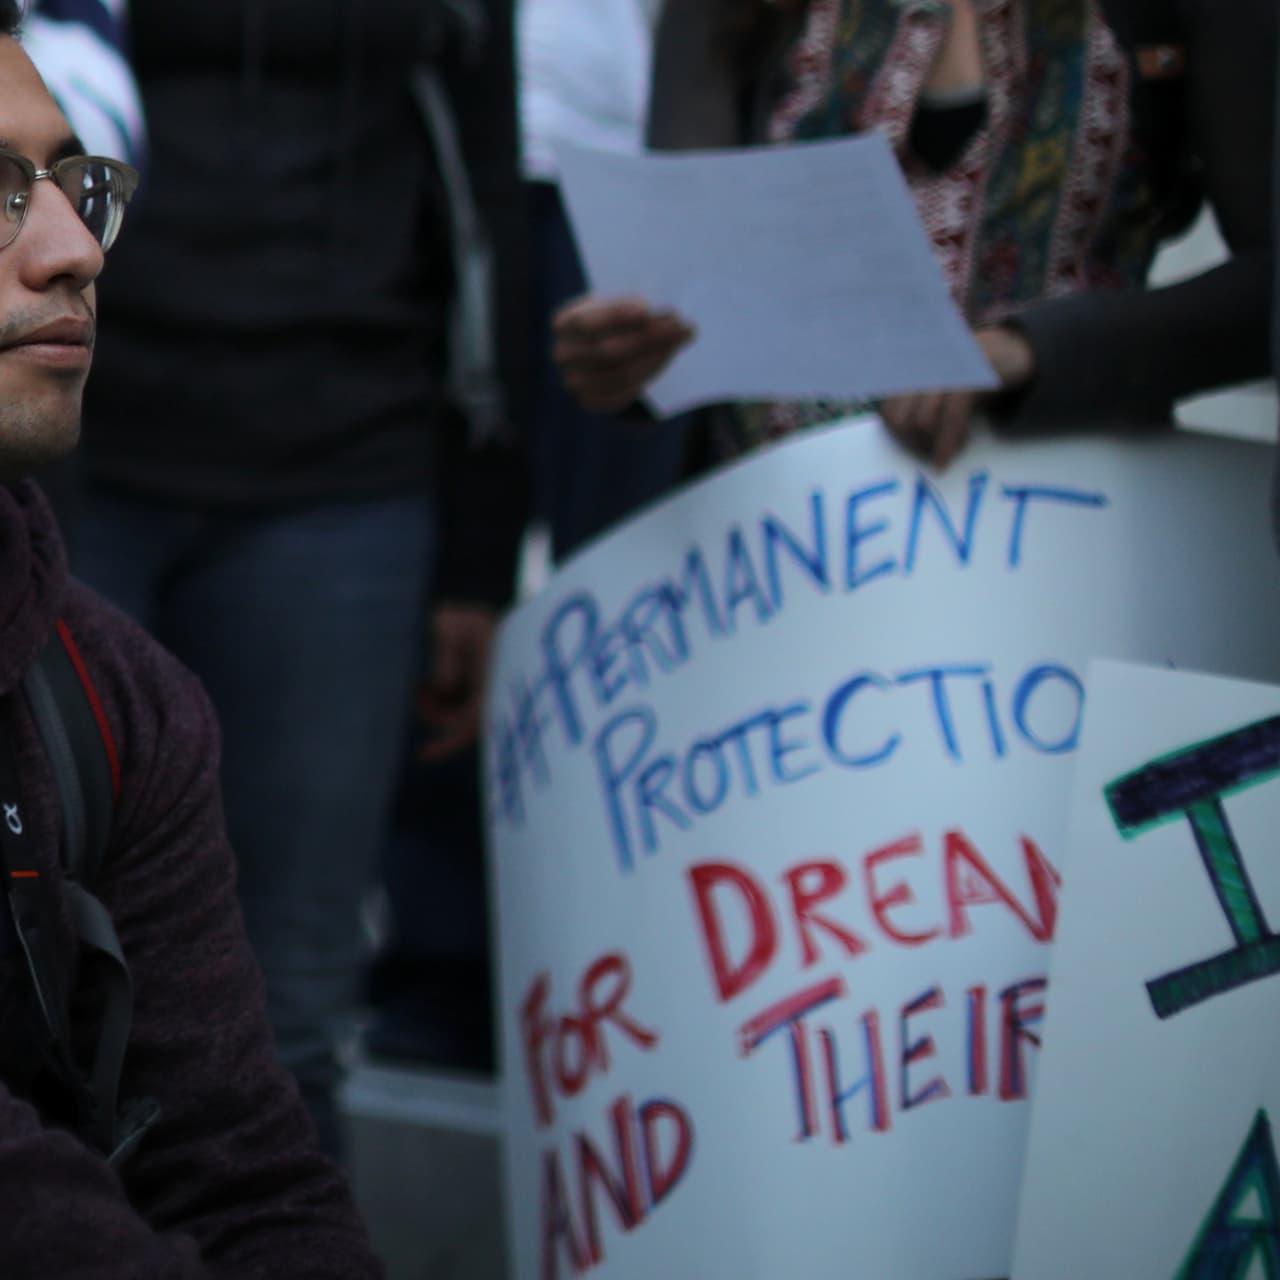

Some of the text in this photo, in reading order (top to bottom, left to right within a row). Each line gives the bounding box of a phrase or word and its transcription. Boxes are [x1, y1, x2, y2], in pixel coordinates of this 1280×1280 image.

[591, 662, 1086, 876] PROTECTIO
[516, 950, 658, 1132] FOR
[538, 1095, 695, 1280] AND
